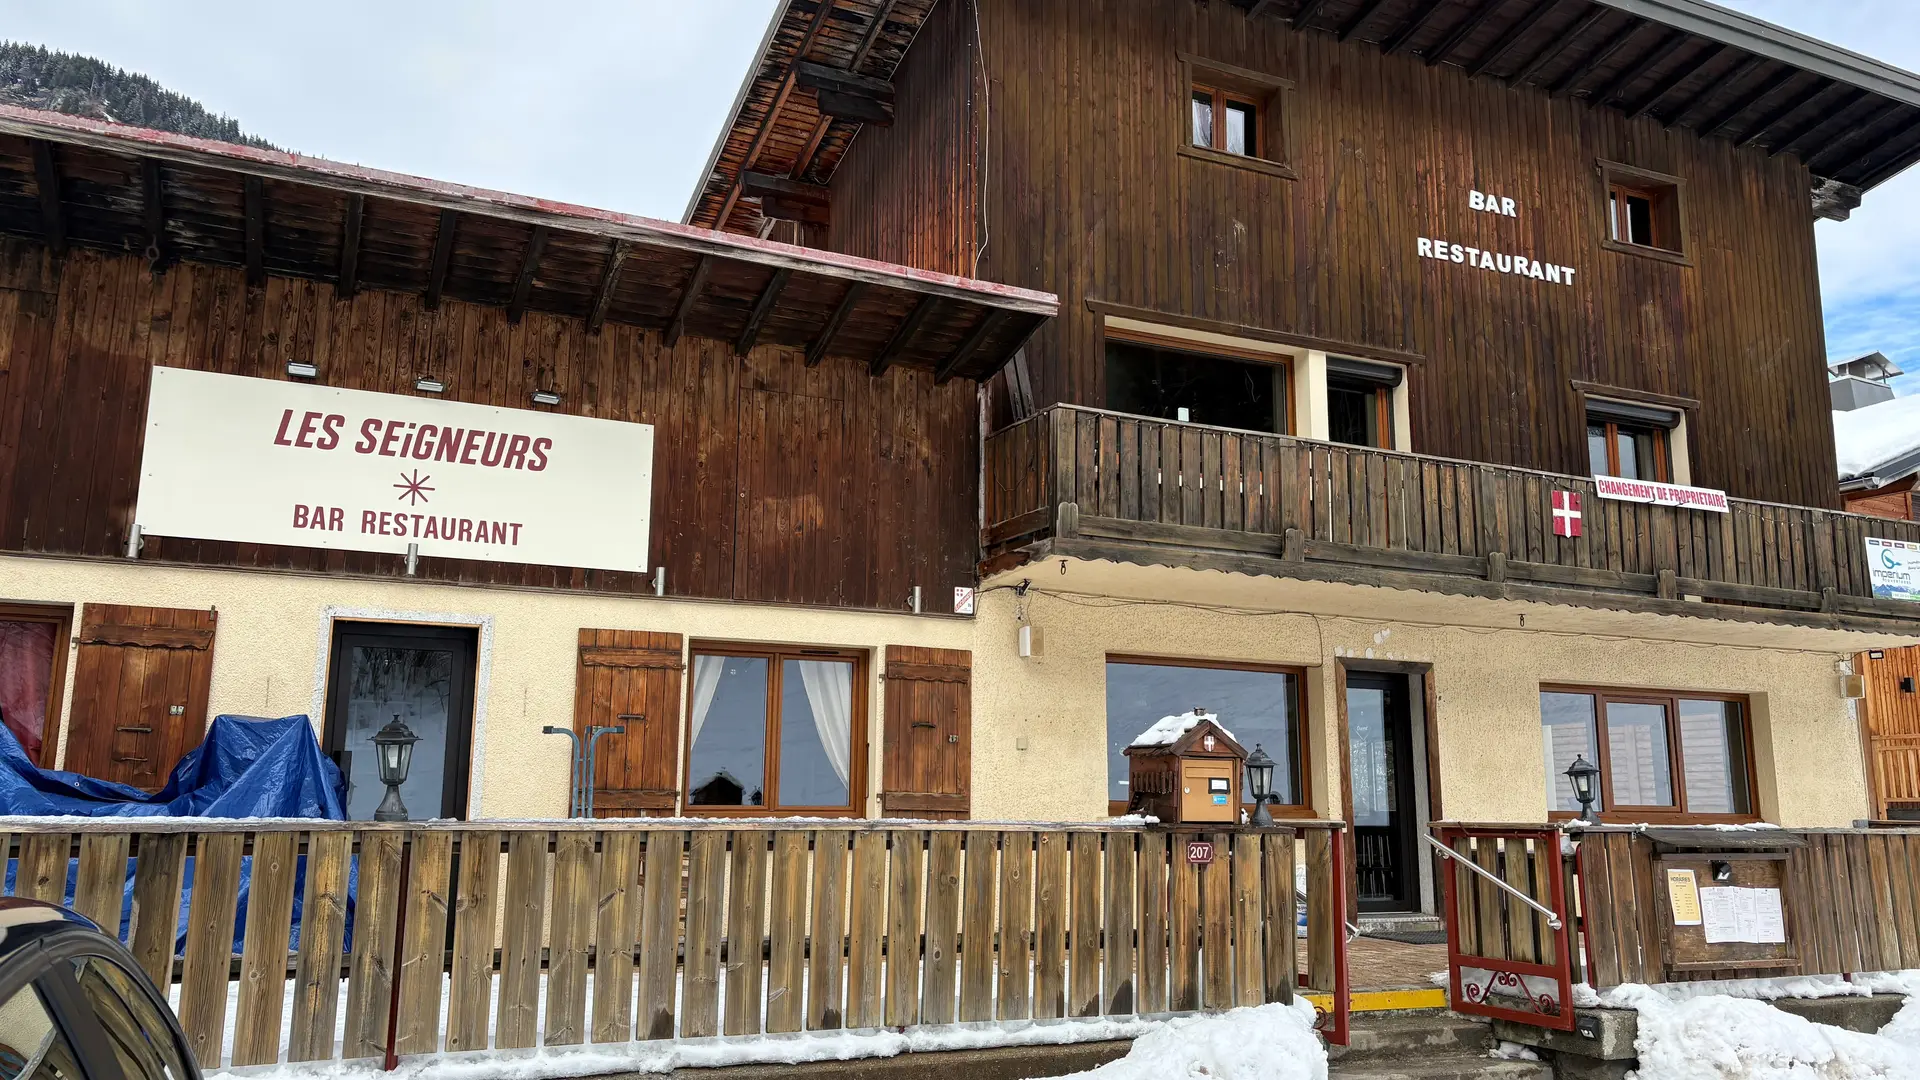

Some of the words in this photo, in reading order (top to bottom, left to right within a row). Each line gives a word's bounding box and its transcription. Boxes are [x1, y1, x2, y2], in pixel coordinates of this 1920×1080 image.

[1468, 189, 1517, 218] BAR
[1417, 237, 1576, 286] RESTAURANT
[274, 409, 345, 450] LES
[1598, 479, 1655, 499] CHANGEMENT
[1656, 486, 1668, 501] DE
[1668, 488, 1726, 508] PROPRIETAIRE
[293, 504, 345, 532] BAR
[361, 510, 523, 546] RESTAURANT
[1873, 568, 1911, 581] imperium
[1190, 846, 1209, 859] 207
